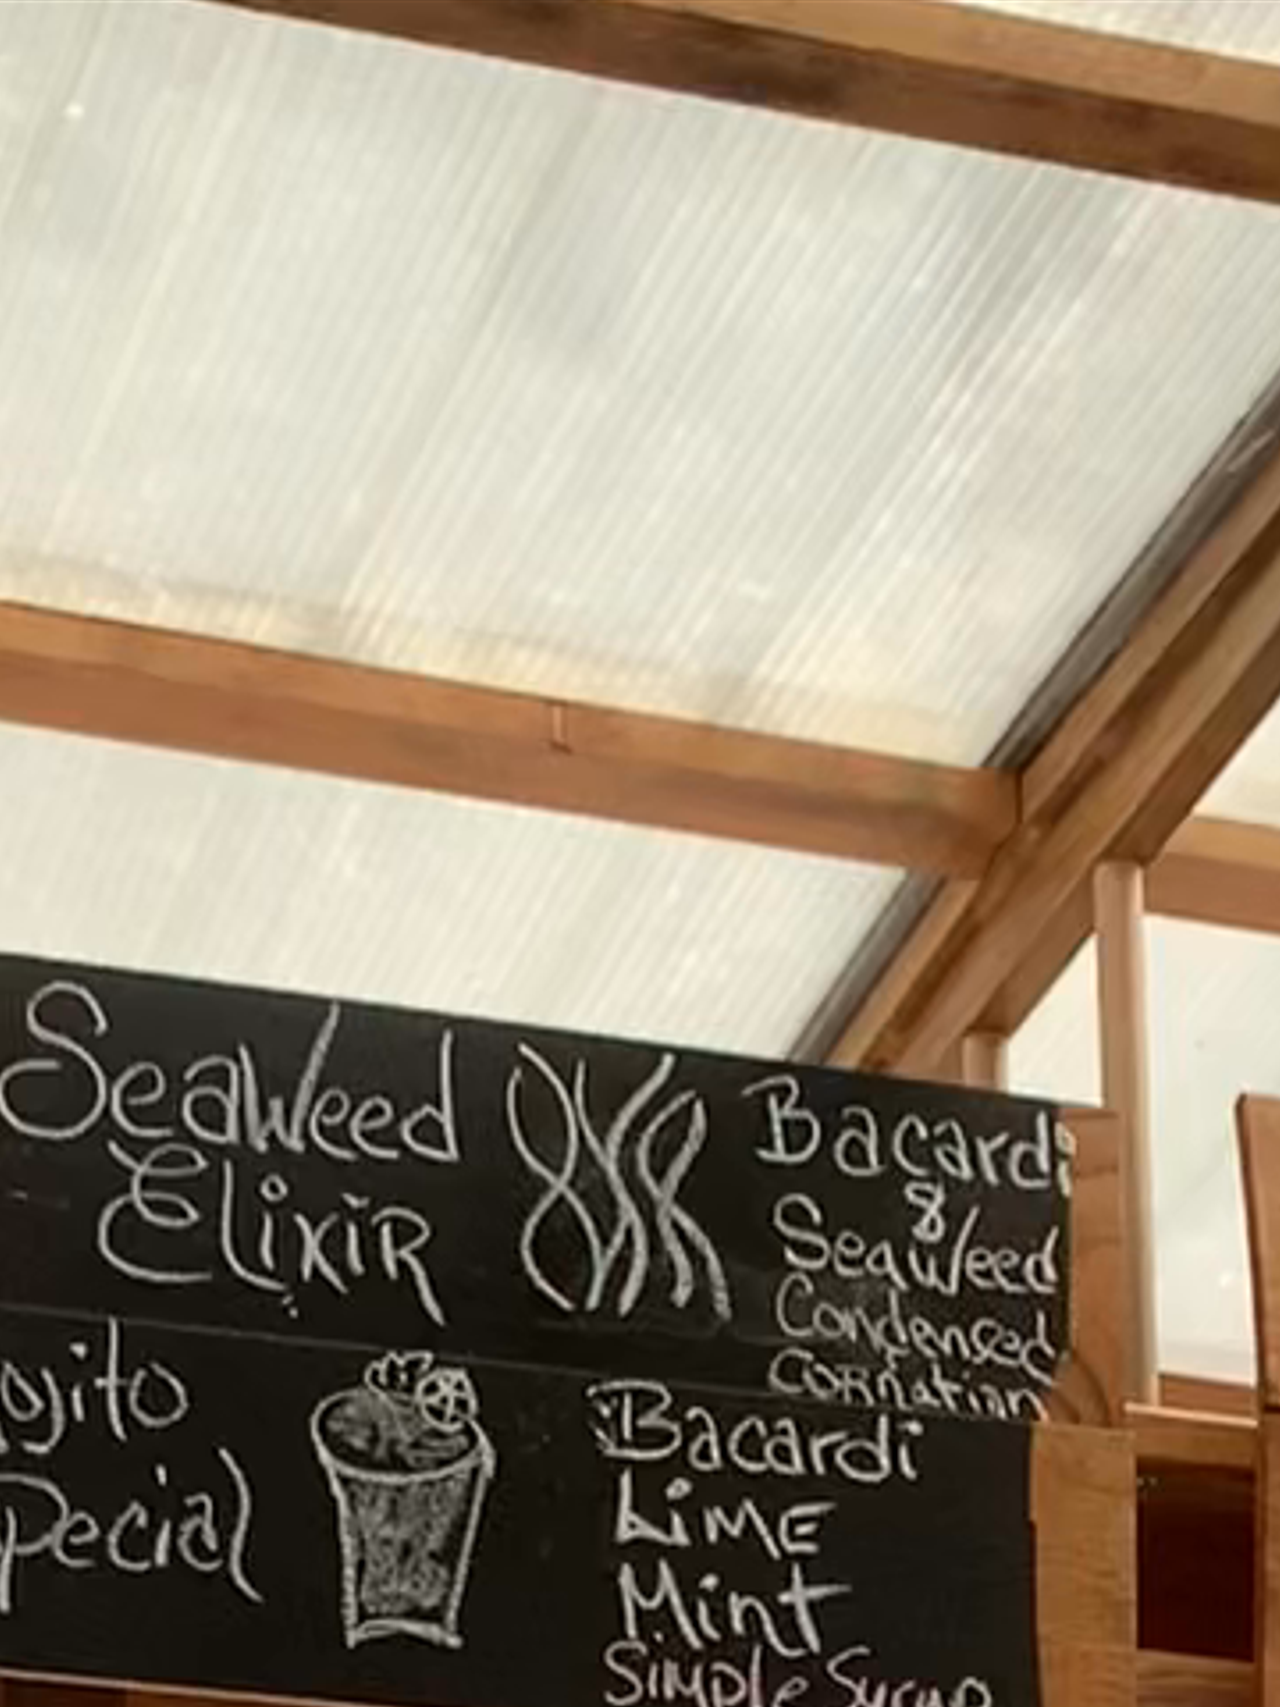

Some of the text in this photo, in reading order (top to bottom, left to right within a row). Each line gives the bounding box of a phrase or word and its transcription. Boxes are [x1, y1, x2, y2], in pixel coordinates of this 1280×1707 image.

[741, 1073, 1077, 1198] Bacardi
[776, 1270, 1057, 1387] Condensed
[586, 1379, 925, 1483] Bacardi
[619, 1557, 852, 1657] Mint
